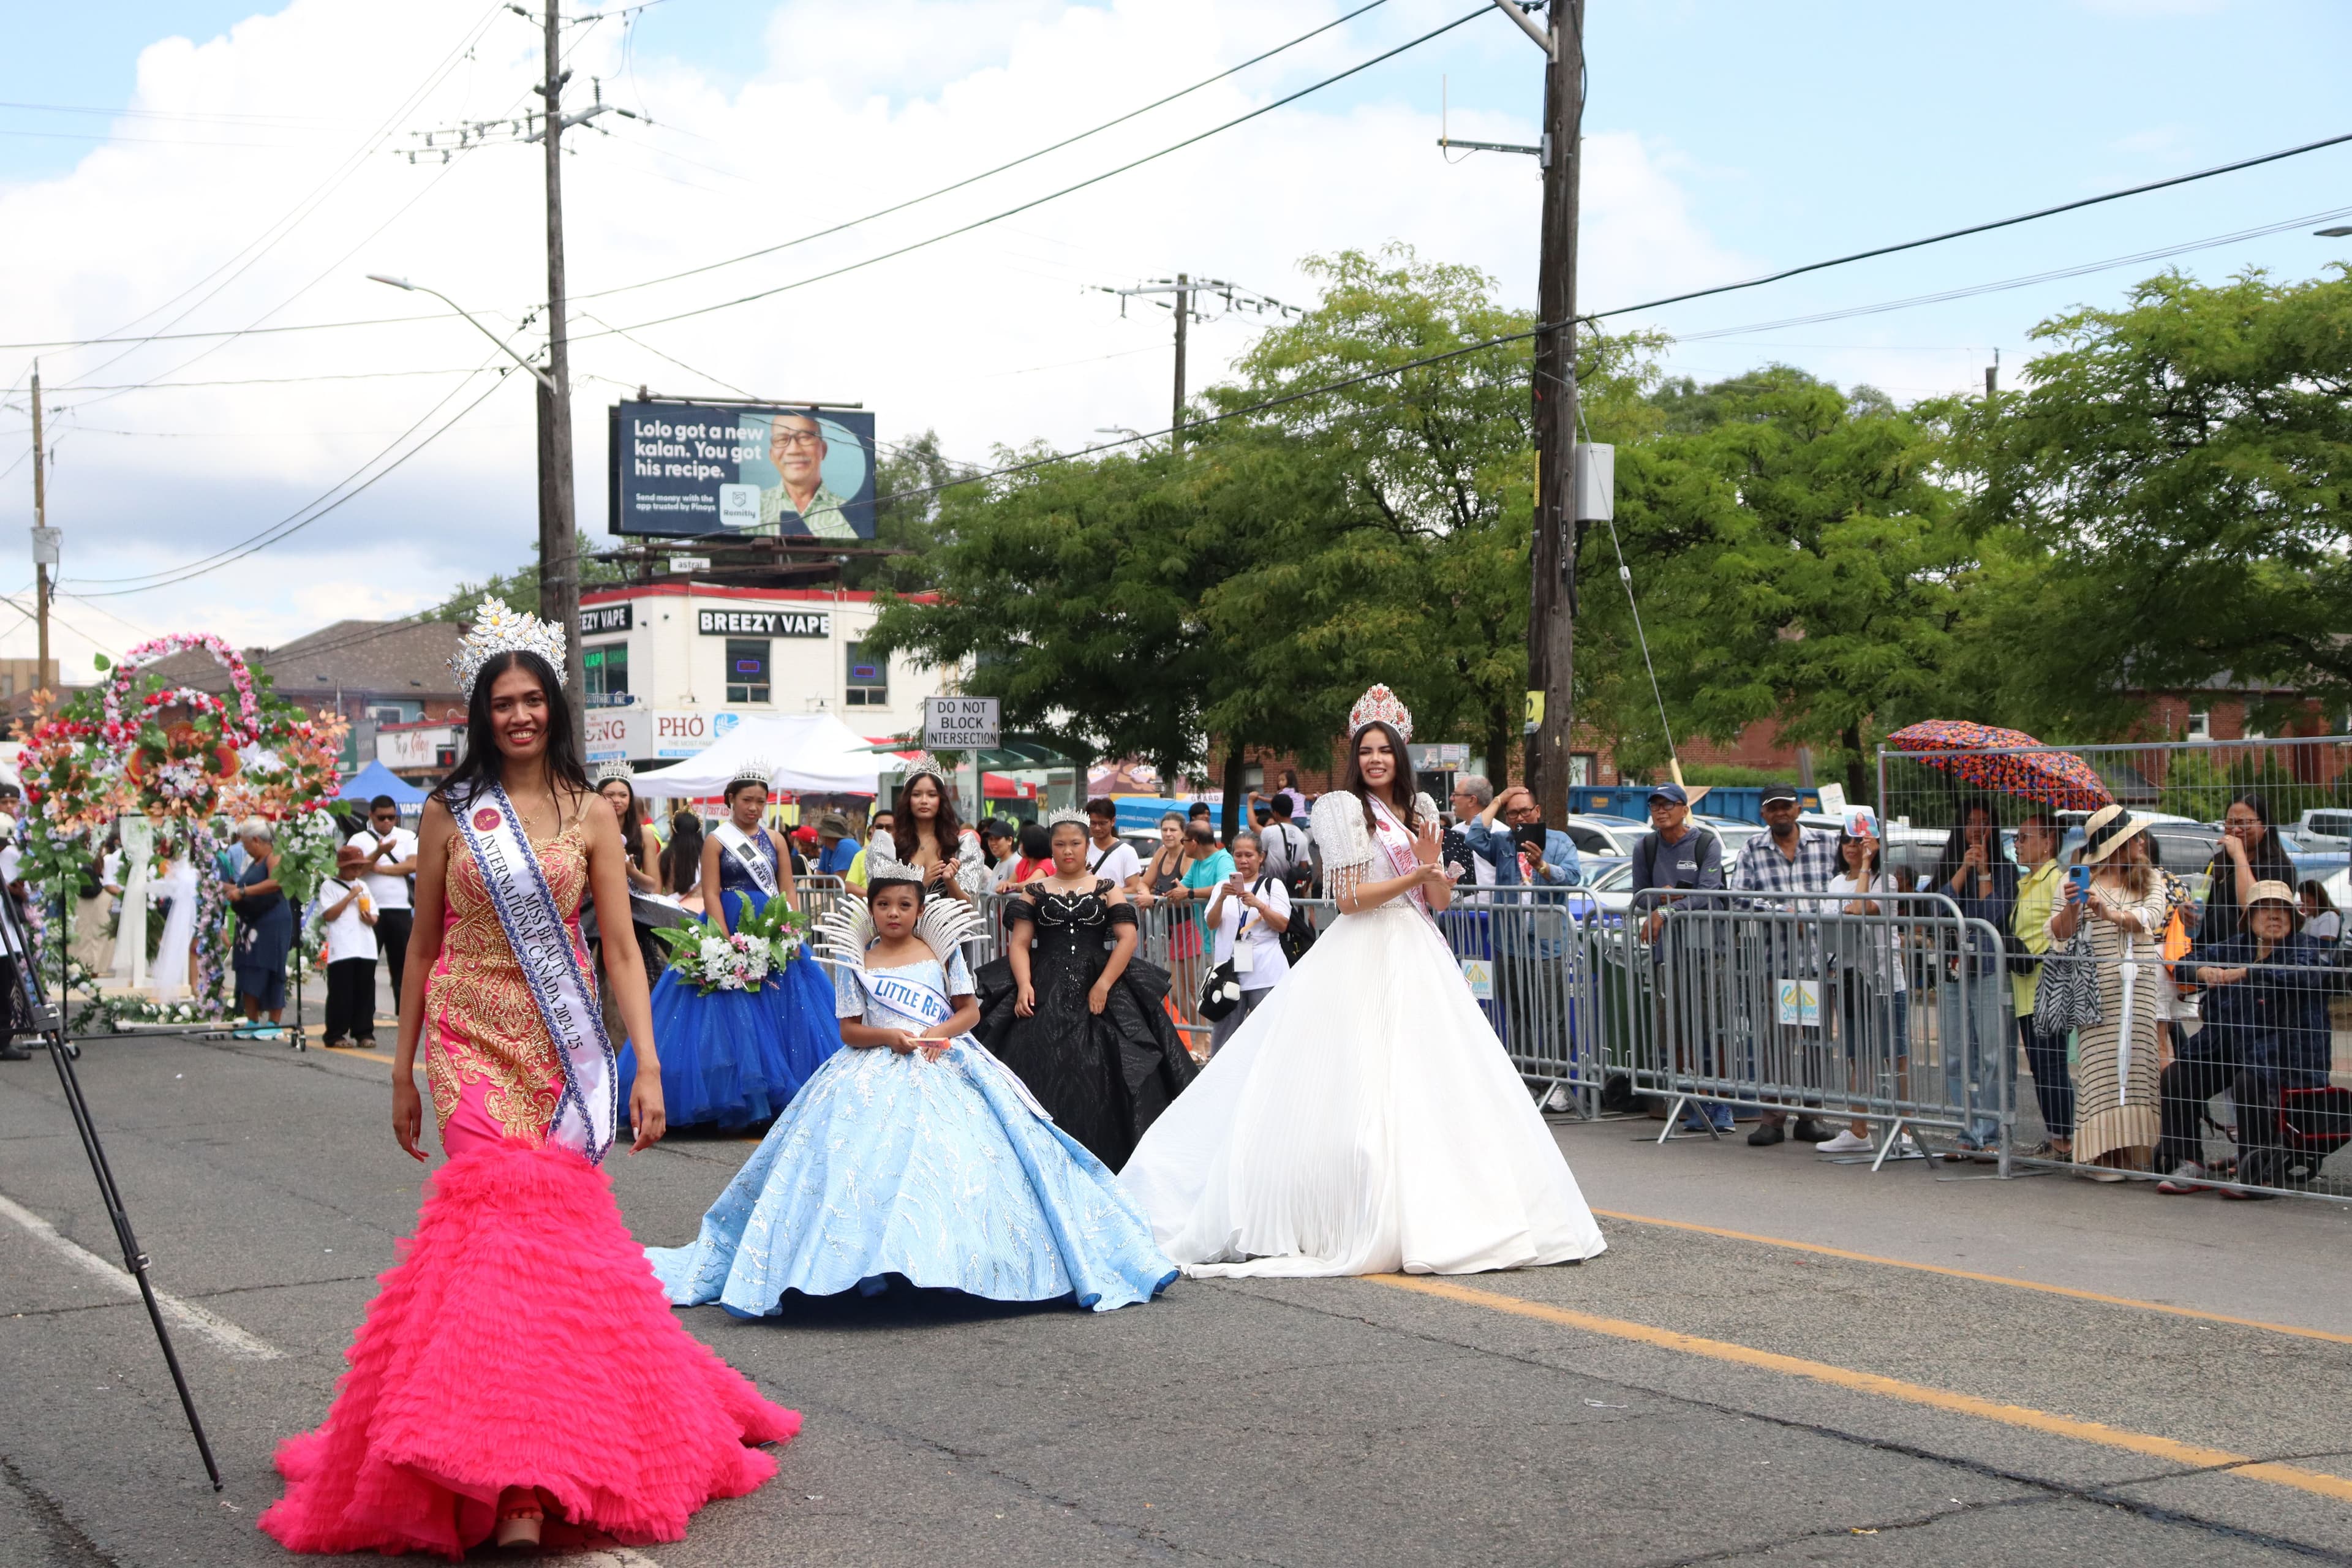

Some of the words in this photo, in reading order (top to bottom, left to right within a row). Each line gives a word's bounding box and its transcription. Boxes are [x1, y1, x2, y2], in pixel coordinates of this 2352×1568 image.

[635, 420, 672, 437] Lolo
[674, 423, 706, 442] got
[709, 426, 722, 439] a
[725, 427, 764, 440] new
[635, 439, 691, 458] kalan.
[695, 441, 727, 459] You
[731, 445, 761, 463] got
[635, 459, 662, 477] his
[665, 460, 725, 481] recipe.
[636, 492, 655, 501] Send
[723, 509, 756, 518] Remitly
[677, 560, 703, 569] astral
[600, 608, 625, 628] VAPE
[700, 612, 776, 632] BREEZY
[781, 614, 829, 634] VAPE
[938, 701, 956, 714] DO
[963, 701, 987, 714] NOT
[941, 717, 984, 729] BLOCK
[928, 732, 997, 744] INTERSECTION
[399, 803, 422, 814] VAPE
[750, 860, 767, 883] STAR
[479, 834, 537, 945] INTERNATIONAL
[528, 944, 561, 1005] CANADA
[553, 1003, 584, 1050] 2024/25
[522, 891, 547, 925] MISS
[537, 925, 570, 979] BEAUTY
[874, 979, 920, 1008] LITTLE
